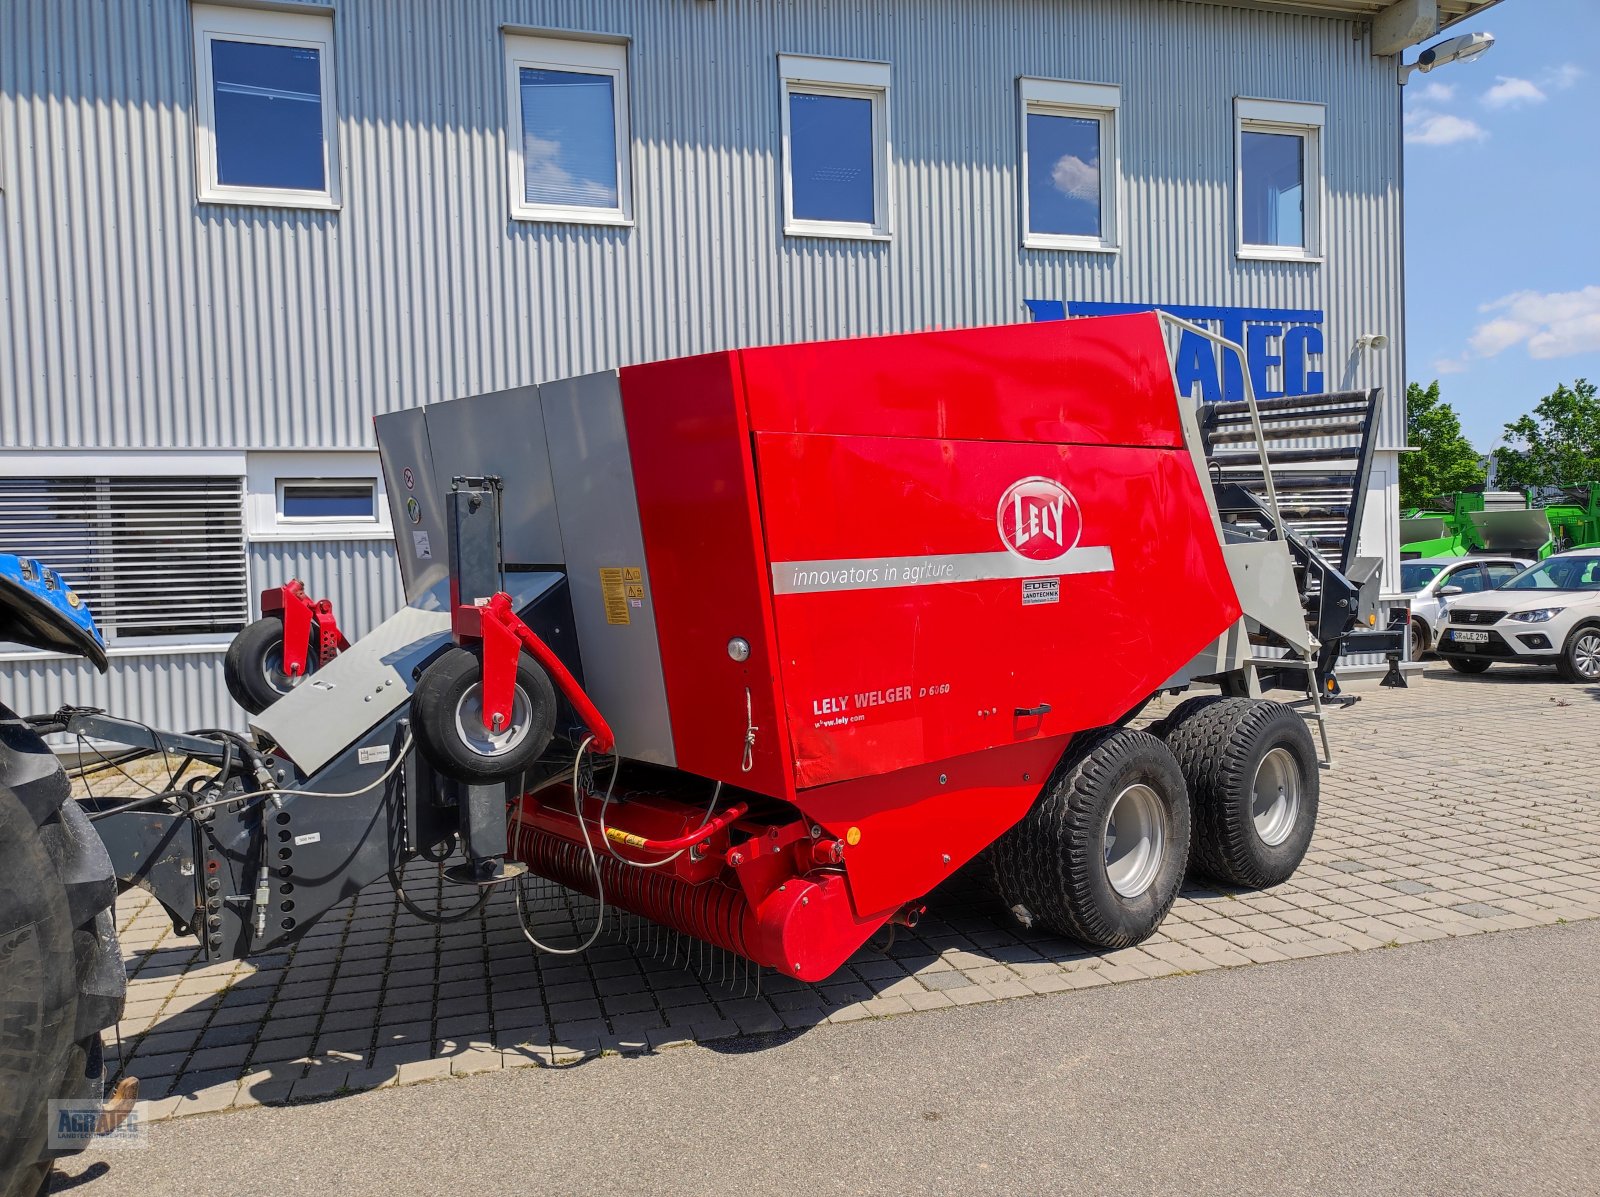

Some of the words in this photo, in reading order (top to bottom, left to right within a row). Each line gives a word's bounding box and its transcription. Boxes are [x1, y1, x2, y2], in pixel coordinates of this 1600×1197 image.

[1014, 493, 1064, 549] LELY
[793, 567, 879, 587] innovators
[884, 564, 898, 581] in
[1024, 581, 1058, 590] EDER
[1022, 590, 1059, 599] LANDTECHNIK
[813, 695, 849, 715] LELY
[854, 685, 912, 708] WELGER
[919, 687, 927, 698] D
